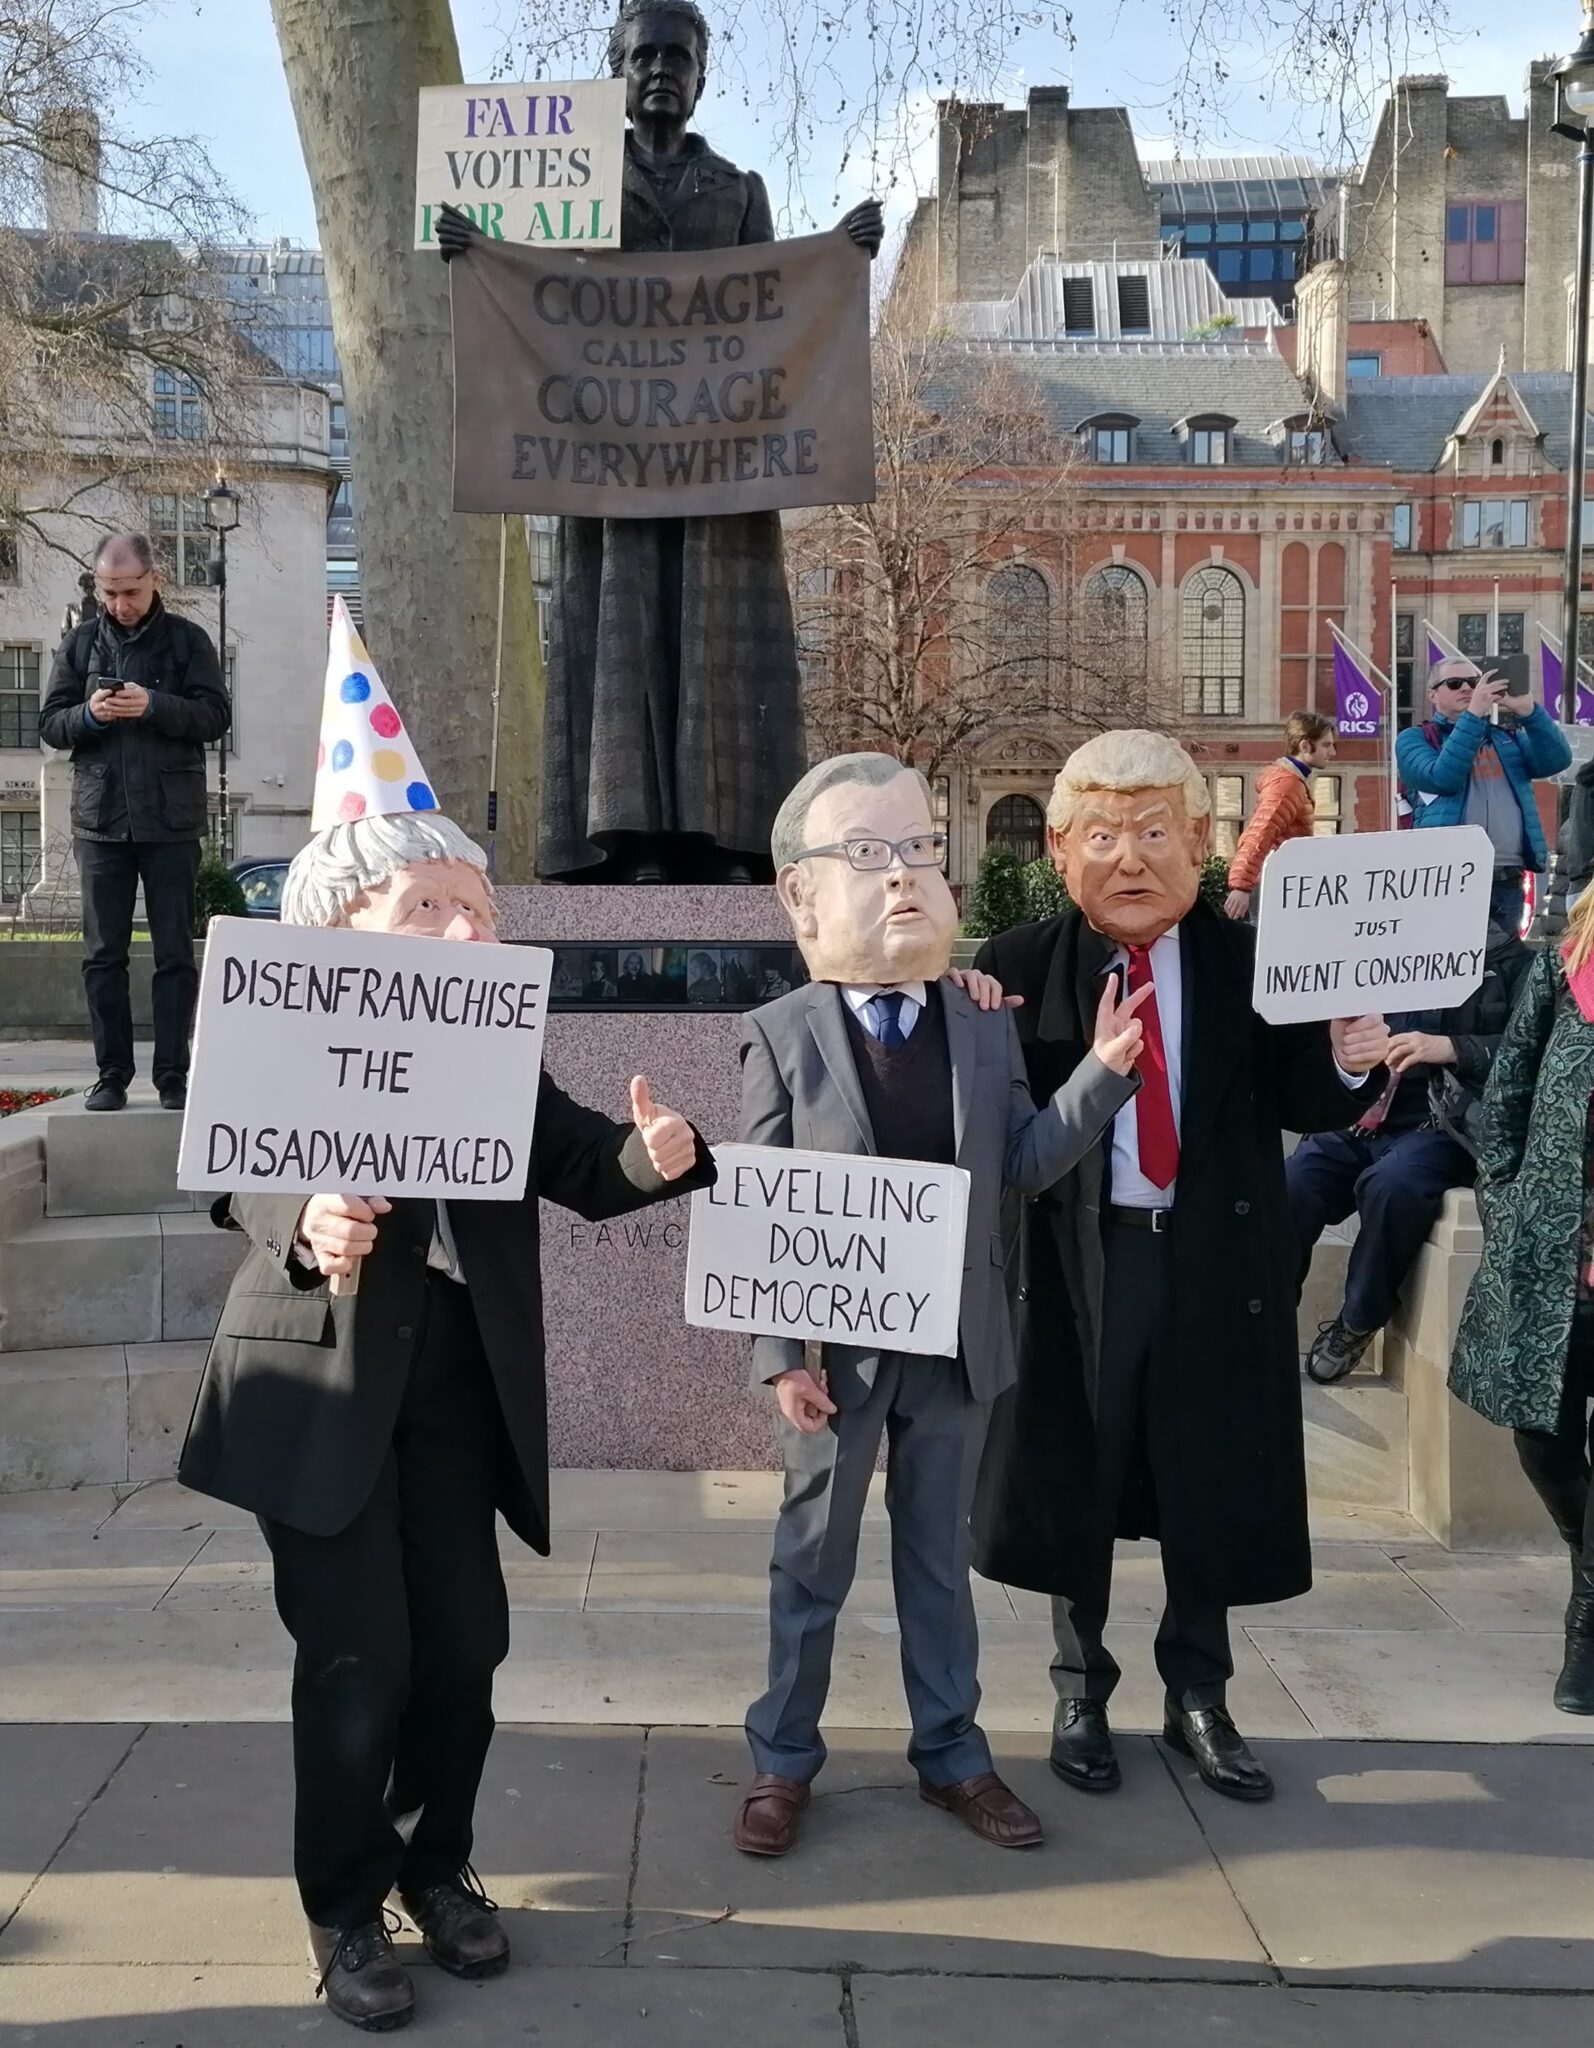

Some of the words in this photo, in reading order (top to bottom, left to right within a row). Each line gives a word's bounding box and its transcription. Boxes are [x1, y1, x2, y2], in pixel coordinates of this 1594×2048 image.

[465, 95, 574, 138] FAIR
[444, 147, 592, 190] VOTES
[525, 199, 614, 241] ALL
[533, 269, 785, 329] COURAGE
[583, 338, 686, 369] CALLS
[704, 335, 745, 364] TO
[537, 367, 788, 428] COURAGE
[511, 428, 819, 488] EVERYWHERE
[1339, 720, 1376, 733] RICS
[1281, 873, 1349, 910] FEAR
[1353, 918, 1403, 938] JUST
[222, 956, 540, 1031] DISENFRANCHISE
[1265, 958, 1346, 995] INVENT
[1354, 947, 1484, 988] CONSPIRACY
[327, 1046, 414, 1094] THE
[207, 1122, 514, 1185] DISADVANTAGED
[708, 1166, 942, 1224] LEVELLING
[769, 1223, 886, 1274] DOWN
[704, 1273, 931, 1334] DEMOCRACY
